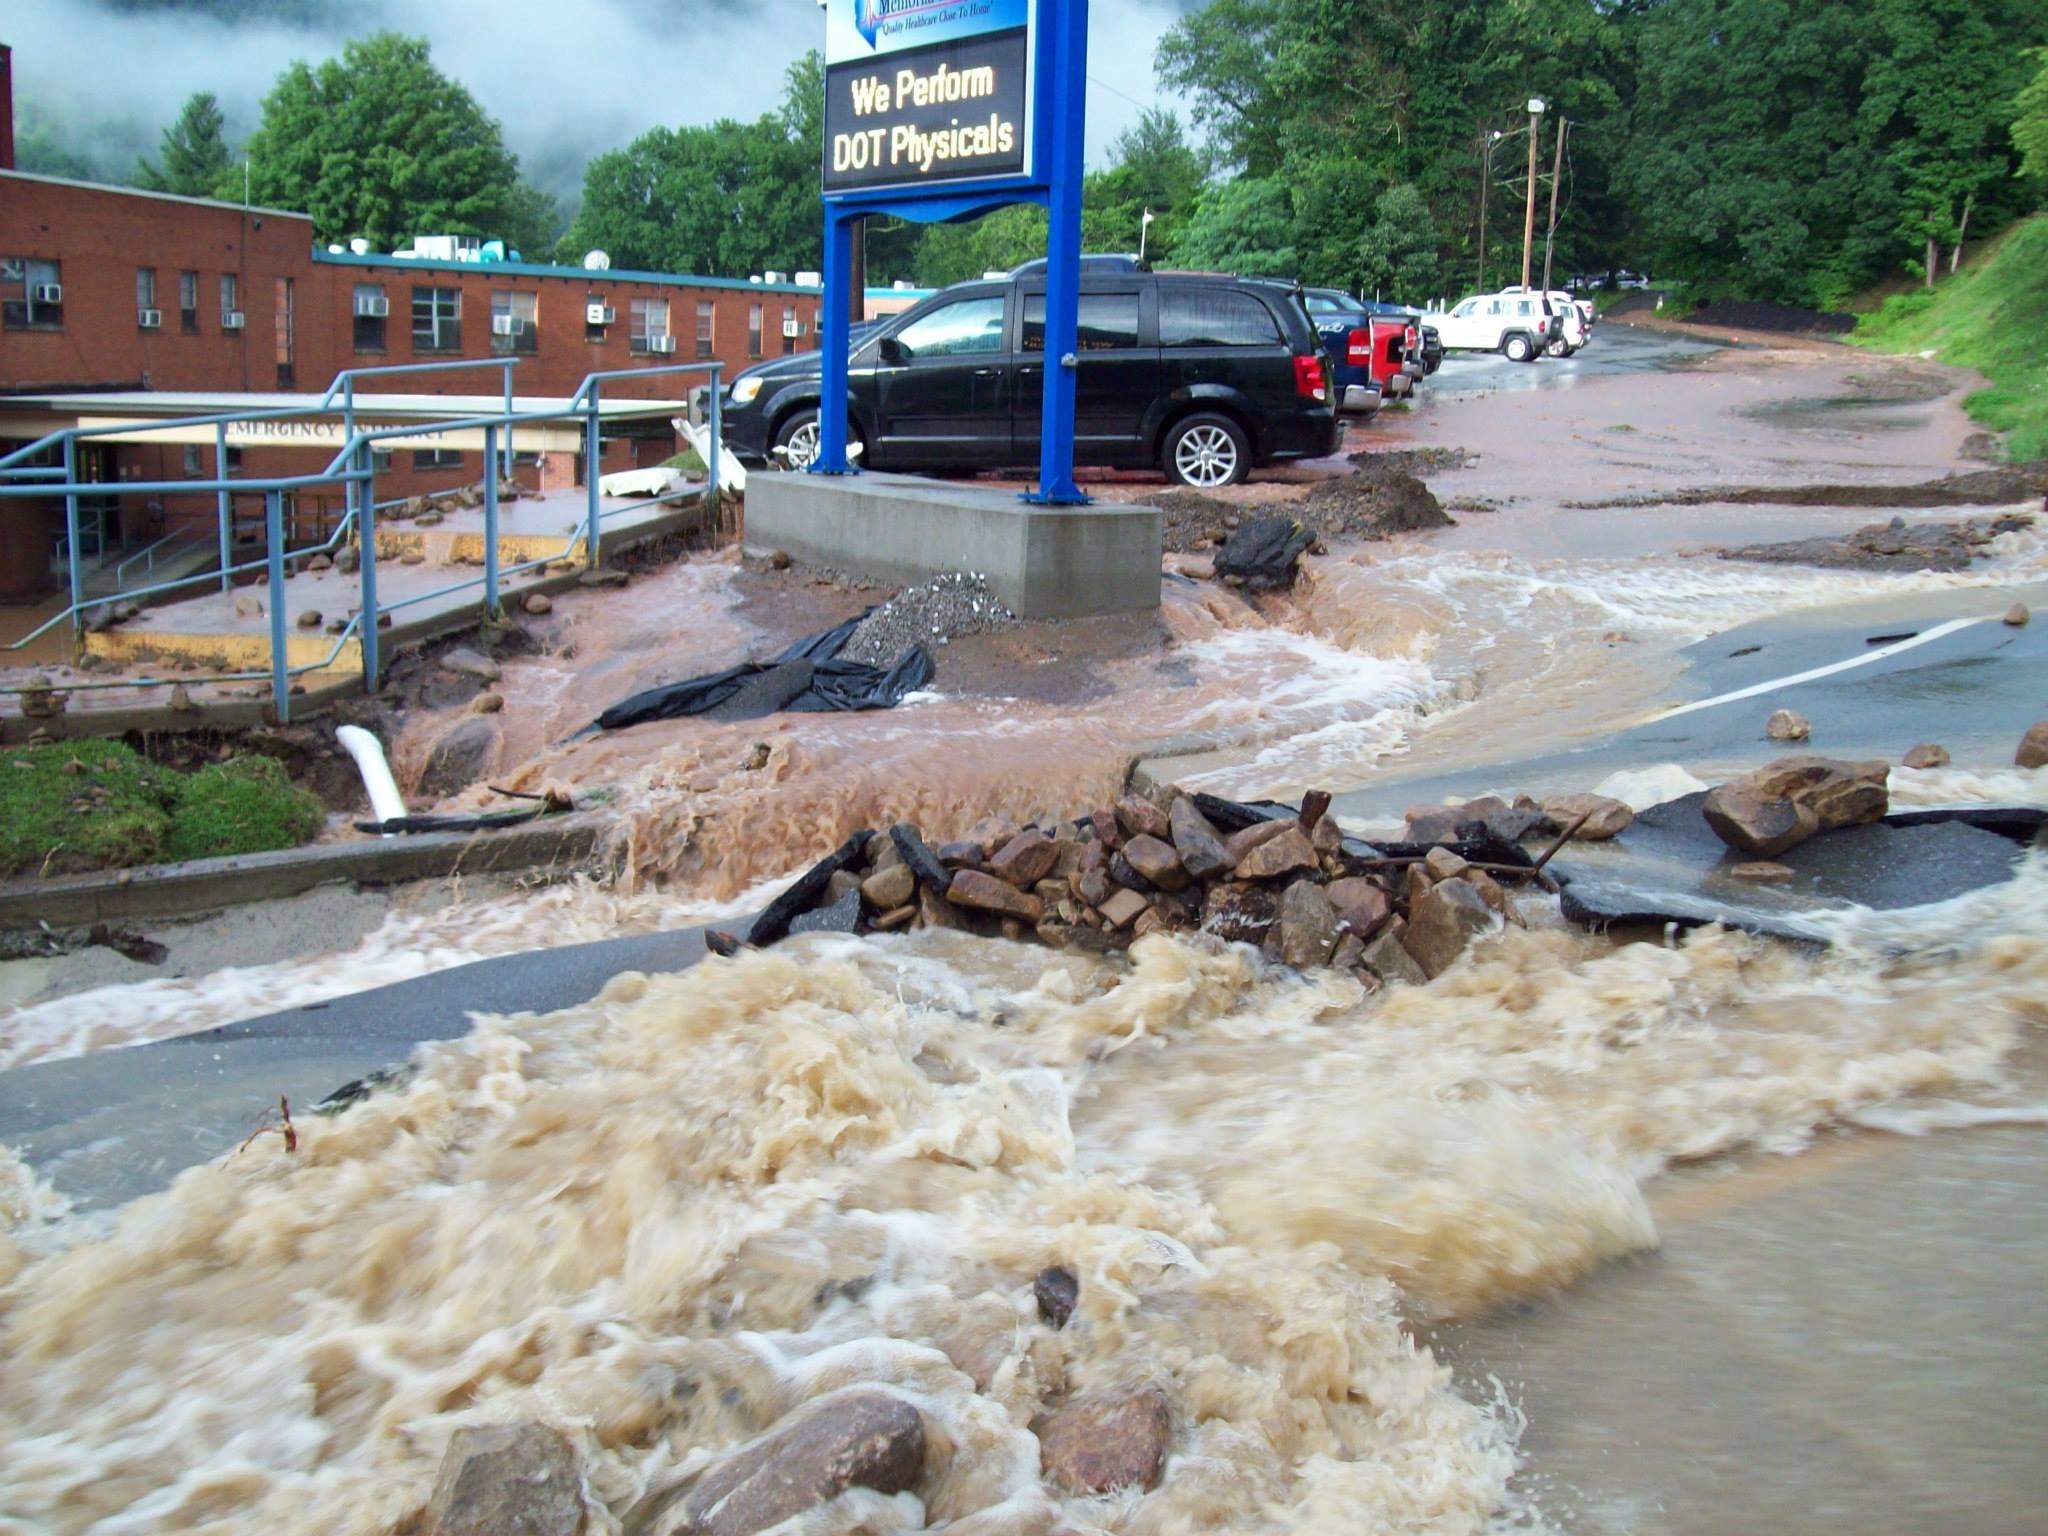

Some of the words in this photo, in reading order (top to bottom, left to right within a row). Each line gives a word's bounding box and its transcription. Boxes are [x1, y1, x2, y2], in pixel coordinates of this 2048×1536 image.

[905, 15, 937, 30] Healthcare
[939, 9, 956, 22] Close
[959, 6, 968, 18] To
[851, 76, 890, 116] We
[896, 63, 993, 109] Perform
[833, 128, 887, 172] DOT
[891, 113, 1014, 172] Physicals
